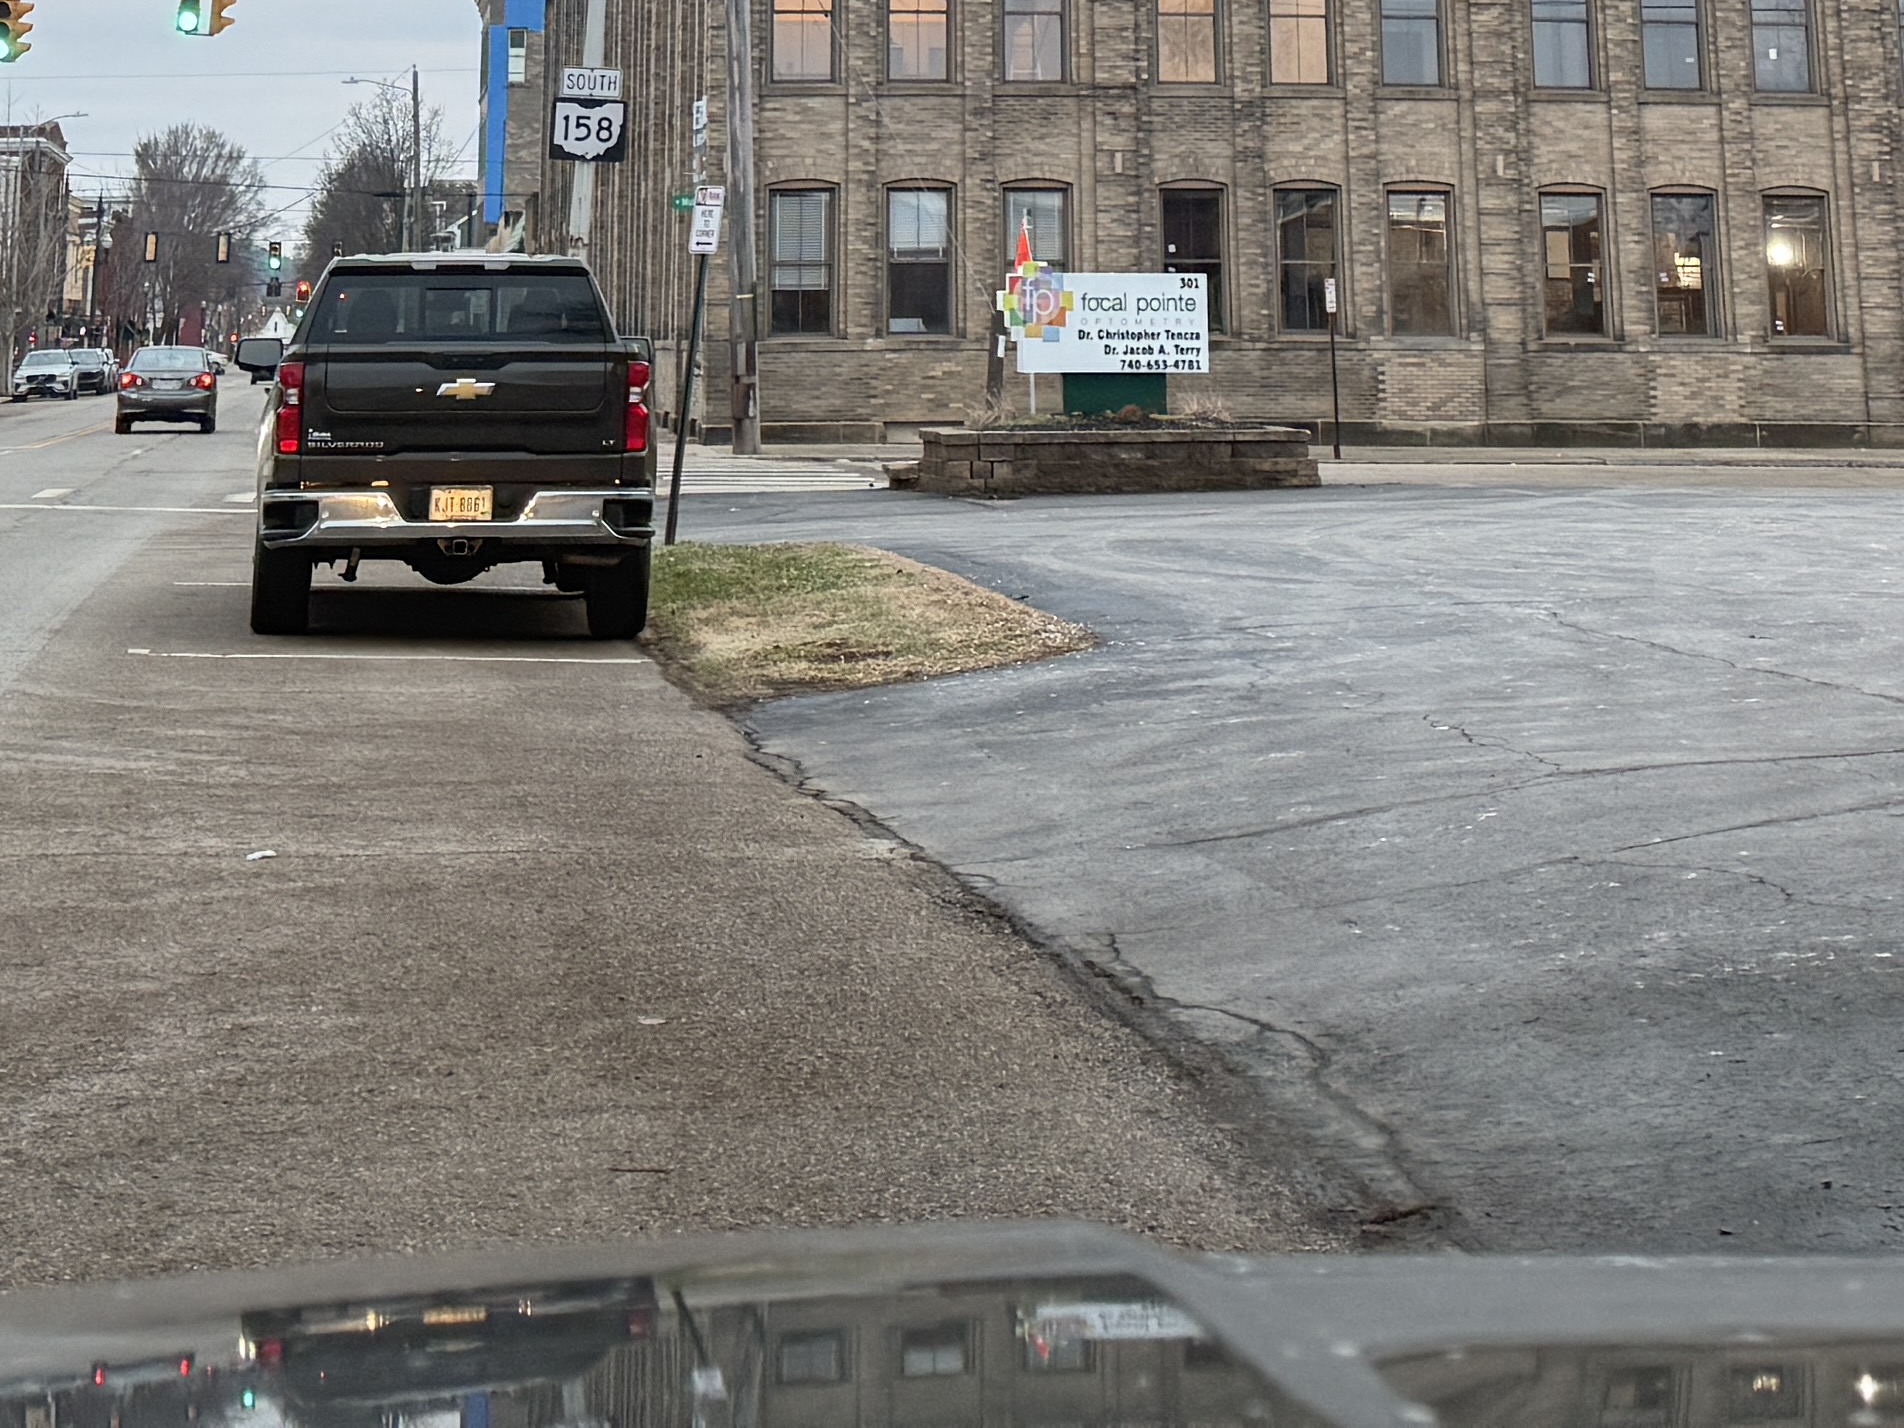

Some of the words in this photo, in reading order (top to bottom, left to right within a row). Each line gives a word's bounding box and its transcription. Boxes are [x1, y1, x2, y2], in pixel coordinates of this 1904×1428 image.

[566, 73, 618, 92] SOUTH
[562, 114, 614, 143] 158
[1179, 277, 1200, 289] 301
[1081, 292, 1128, 312] focal
[1136, 292, 1197, 316] pointe
[1080, 317, 1196, 326] OPTOMETRY
[1078, 330, 1094, 341] Dr.
[1098, 329, 1161, 344] Christopher
[1164, 330, 1201, 341] Tencza
[1104, 345, 1119, 356] Dr.
[1122, 344, 1155, 356] Jacob
[1158, 345, 1171, 356] A.
[1174, 345, 1202, 358] Terry
[1120, 359, 1202, 371] 740-653-4781
